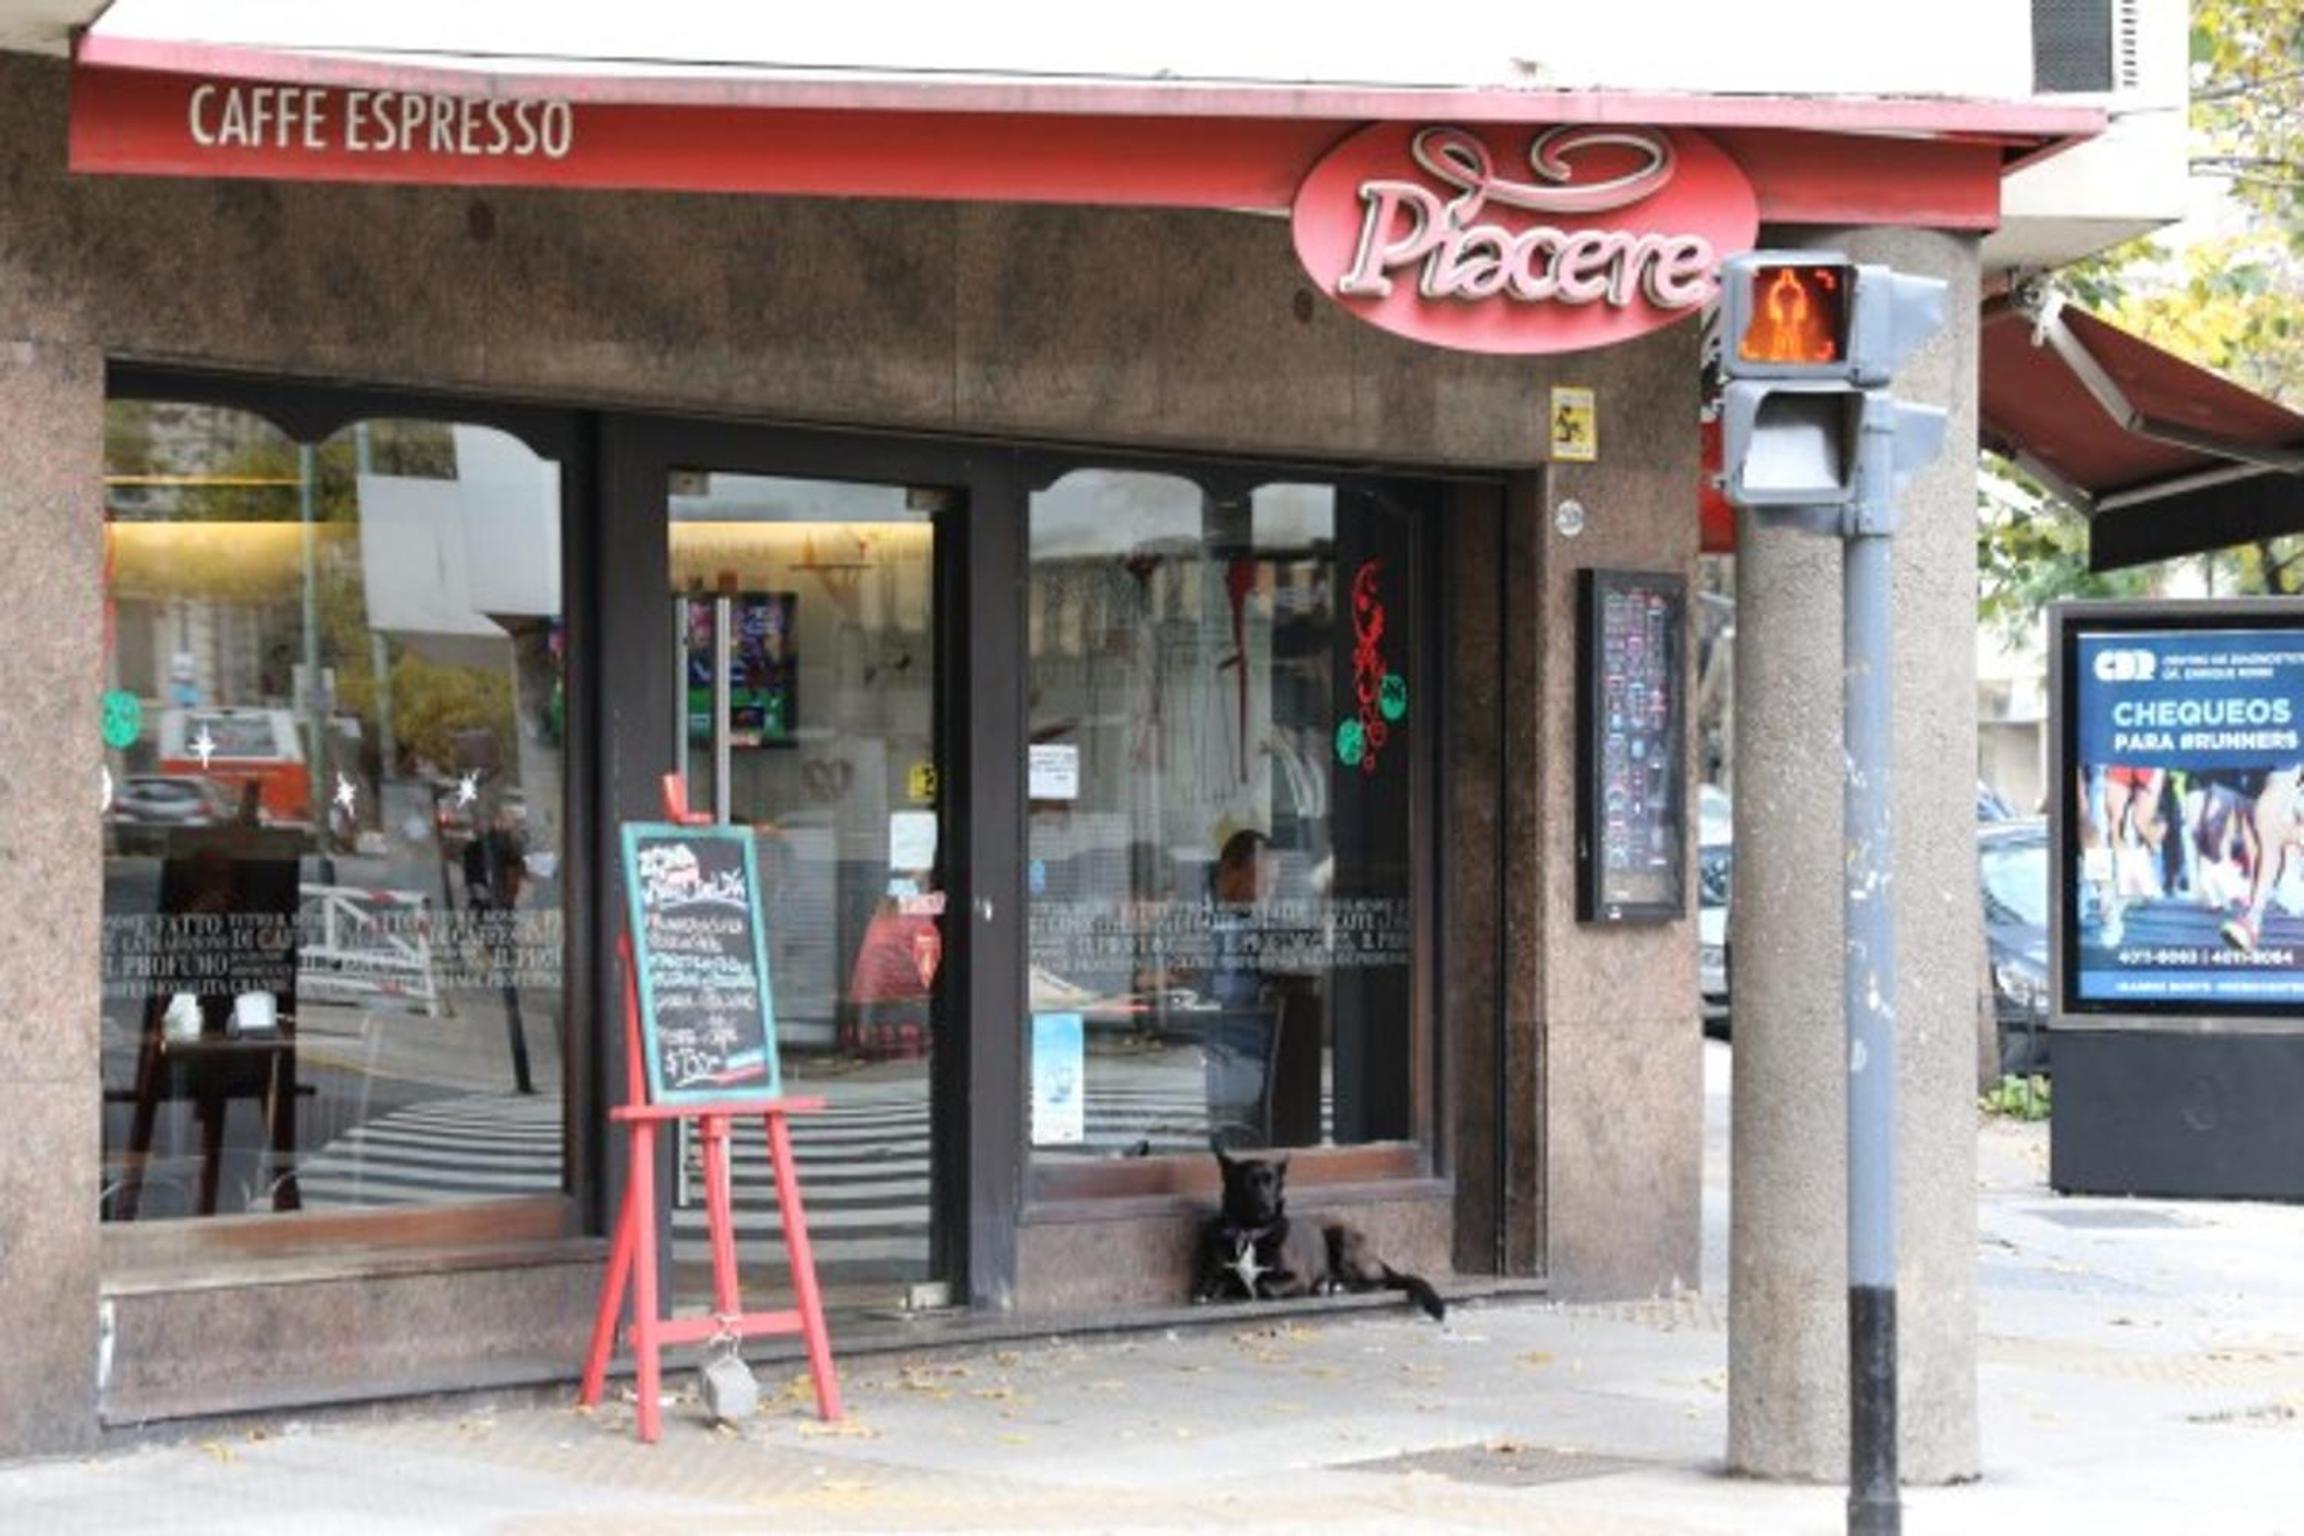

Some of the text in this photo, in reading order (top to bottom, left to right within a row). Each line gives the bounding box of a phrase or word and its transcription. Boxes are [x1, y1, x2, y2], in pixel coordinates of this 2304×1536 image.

[189, 84, 574, 159] CAFFE ESPRESSO
[1337, 178, 1722, 308] Piacere
[2113, 698, 2292, 727] CHEQUEOS
[2115, 733, 2175, 752] PARA
